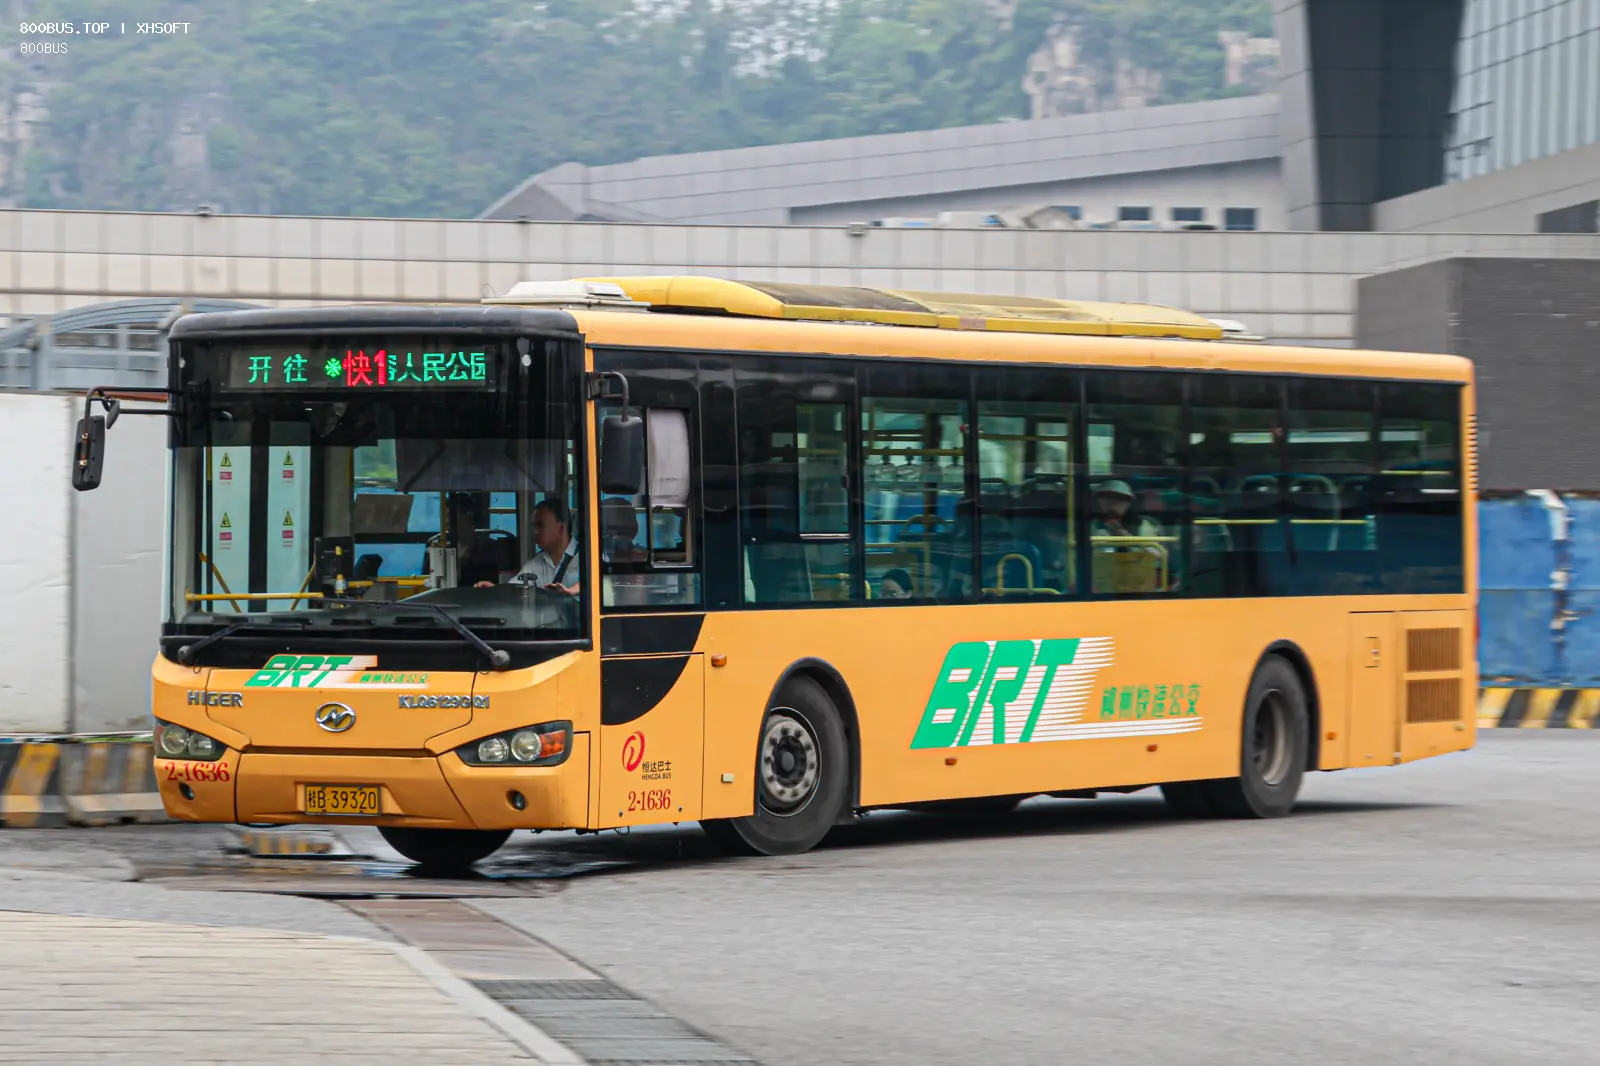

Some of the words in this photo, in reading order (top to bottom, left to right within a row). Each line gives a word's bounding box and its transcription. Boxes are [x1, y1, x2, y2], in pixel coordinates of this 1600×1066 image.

[248, 353, 308, 383] 开往
[244, 655, 353, 688] BRT
[187, 690, 244, 708] HIGER
[909, 637, 1081, 750] BRT
[164, 761, 231, 782] 2-1636
[642, 760, 672, 772] 恒达巴士
[627, 788, 671, 812] 2-1636
